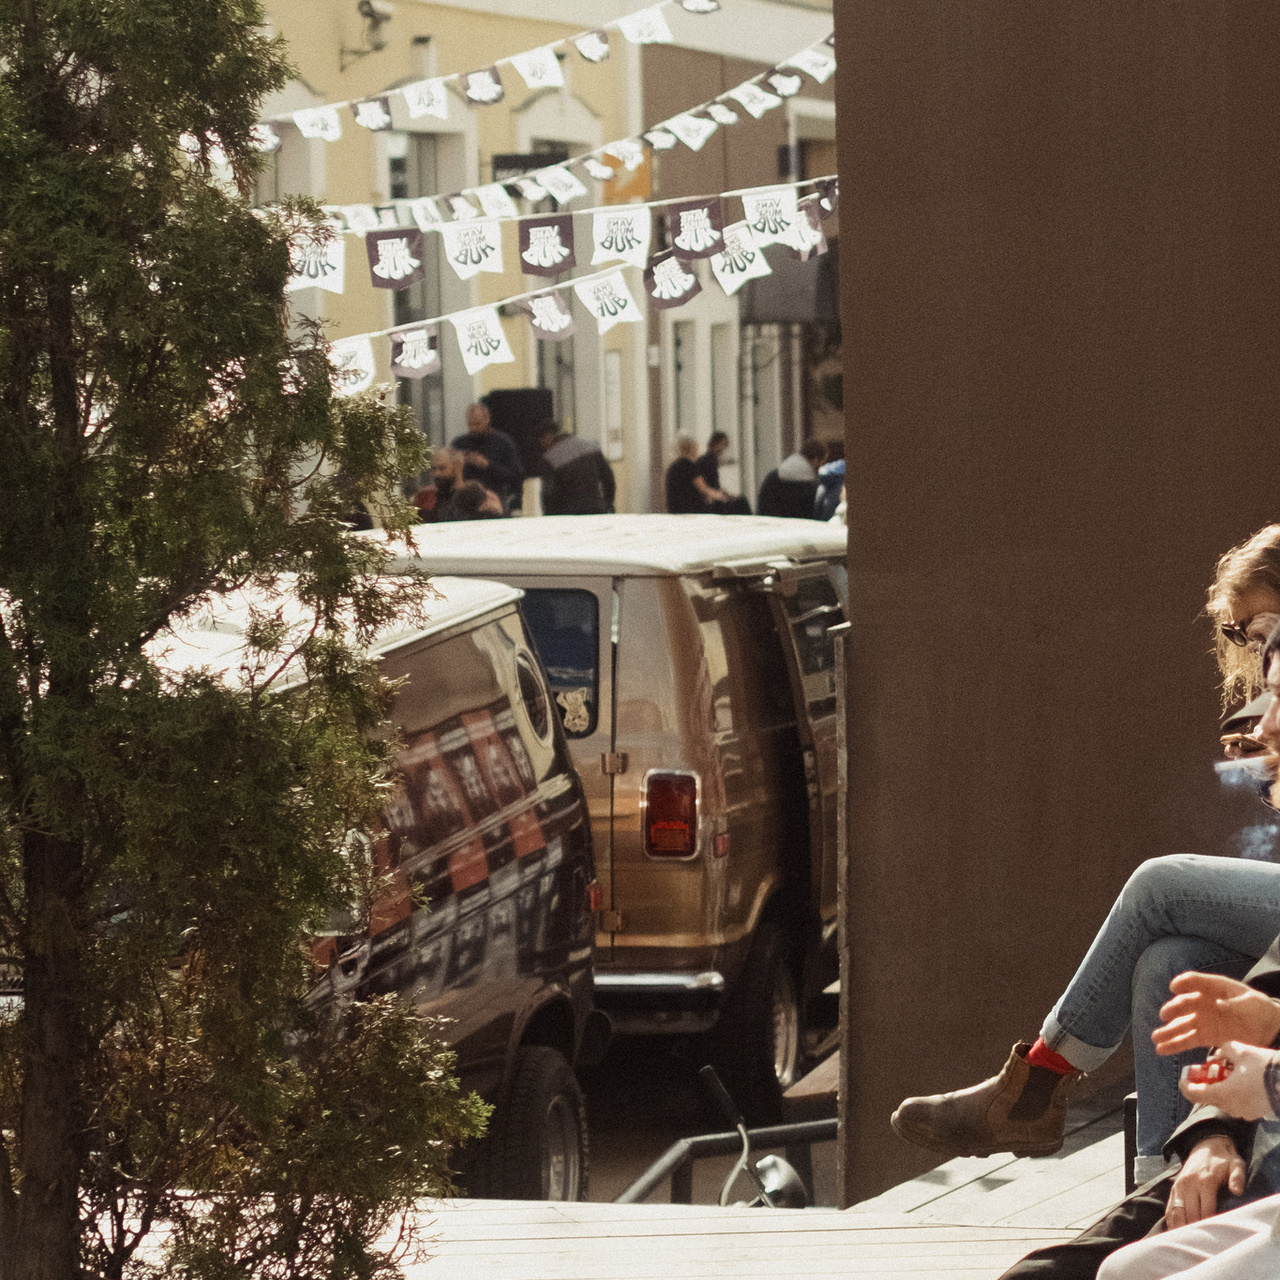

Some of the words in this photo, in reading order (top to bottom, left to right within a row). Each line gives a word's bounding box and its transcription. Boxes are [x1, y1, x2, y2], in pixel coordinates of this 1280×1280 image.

[721, 249, 756, 274] HUB
[596, 296, 628, 317] HUB
[466, 337, 501, 357] HUB
